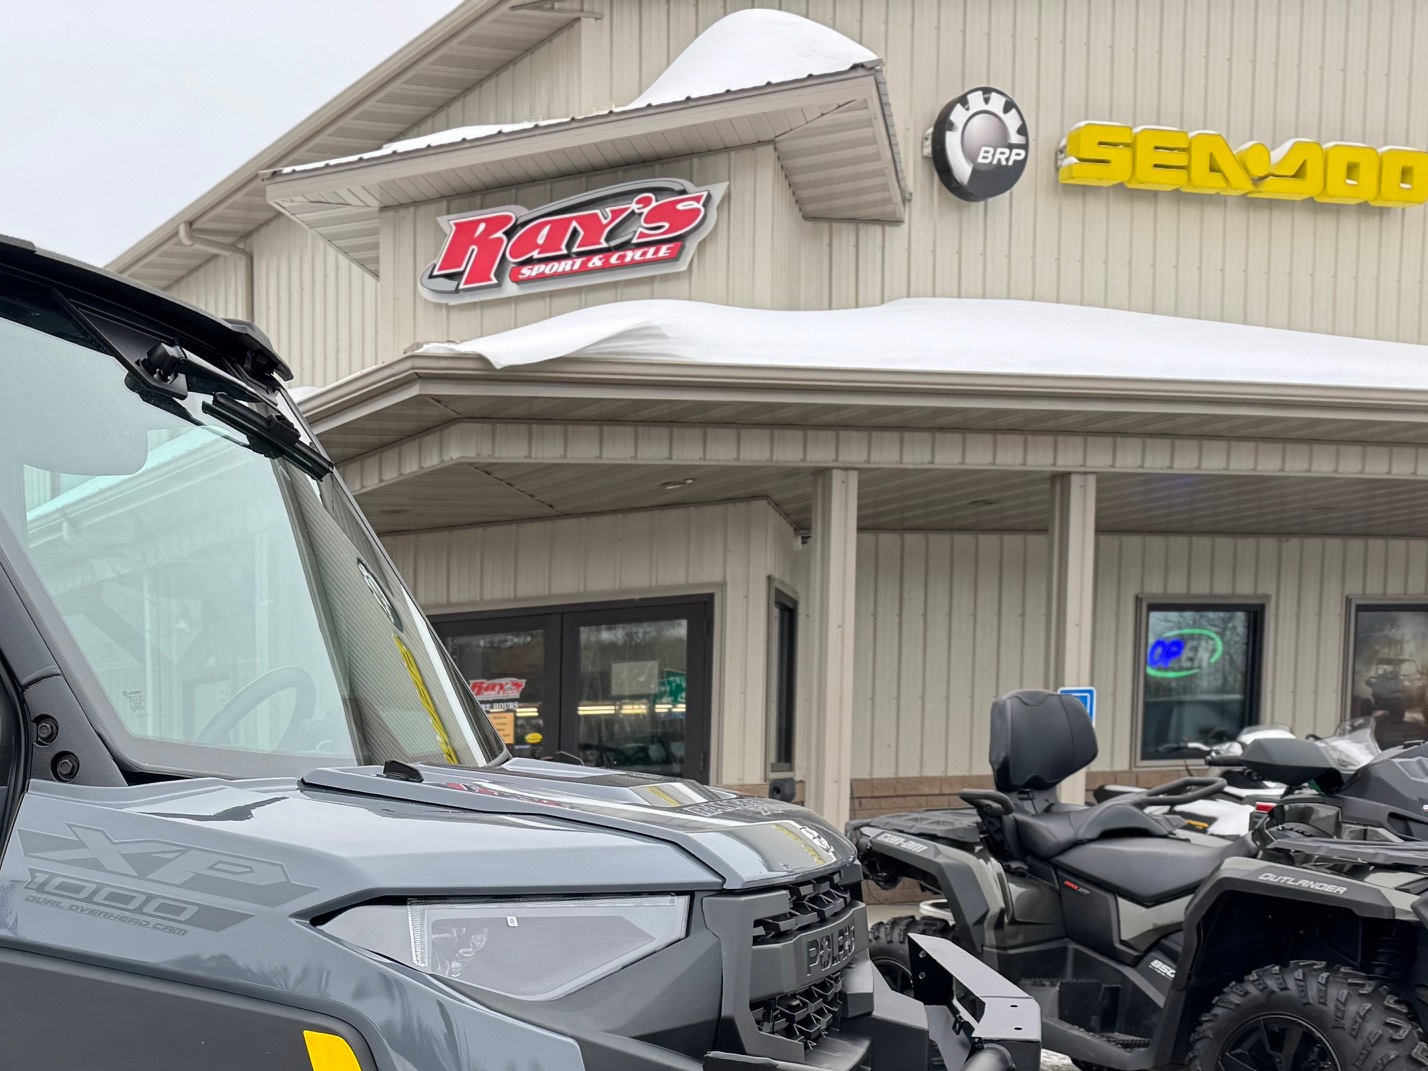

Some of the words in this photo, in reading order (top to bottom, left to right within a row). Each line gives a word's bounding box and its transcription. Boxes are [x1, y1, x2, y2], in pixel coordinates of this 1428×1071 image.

[976, 146, 1026, 166] BRP
[517, 256, 582, 280] SPORT
[587, 253, 607, 268] &
[609, 243, 673, 265] CYCLE
[493, 701, 519, 710] HOURS
[25, 822, 290, 886] XP
[876, 833, 928, 853] can-am
[23, 870, 199, 922] 1000
[1258, 872, 1347, 895] OUTLANDER
[25, 895, 64, 910] DUAL
[68, 904, 150, 928] OVERHEAD
[153, 922, 189, 936] CAM
